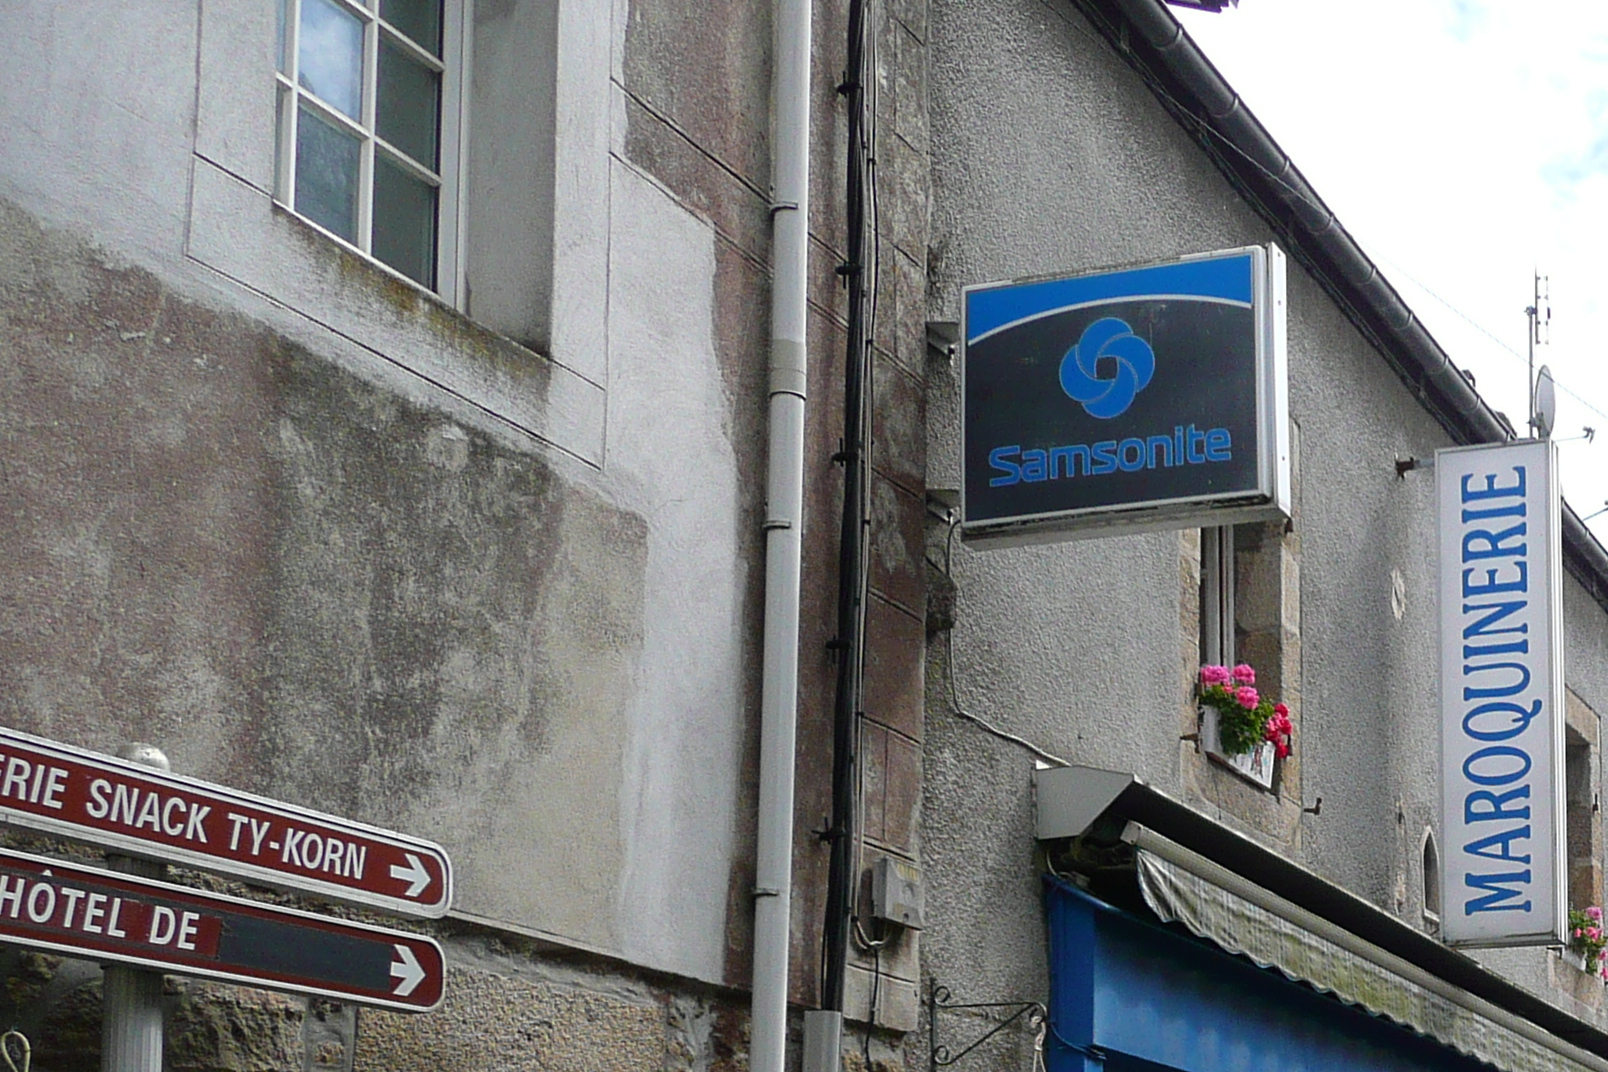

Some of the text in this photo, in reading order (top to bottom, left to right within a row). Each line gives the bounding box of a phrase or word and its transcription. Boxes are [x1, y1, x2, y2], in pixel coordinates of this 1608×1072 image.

[988, 424, 1232, 487] Samsonite
[1460, 464, 1542, 917] MAROQUINERIE
[85, 778, 213, 844] SNACK
[227, 812, 368, 880] TY-KORN
[0, 869, 201, 951] HÔTEL DE
